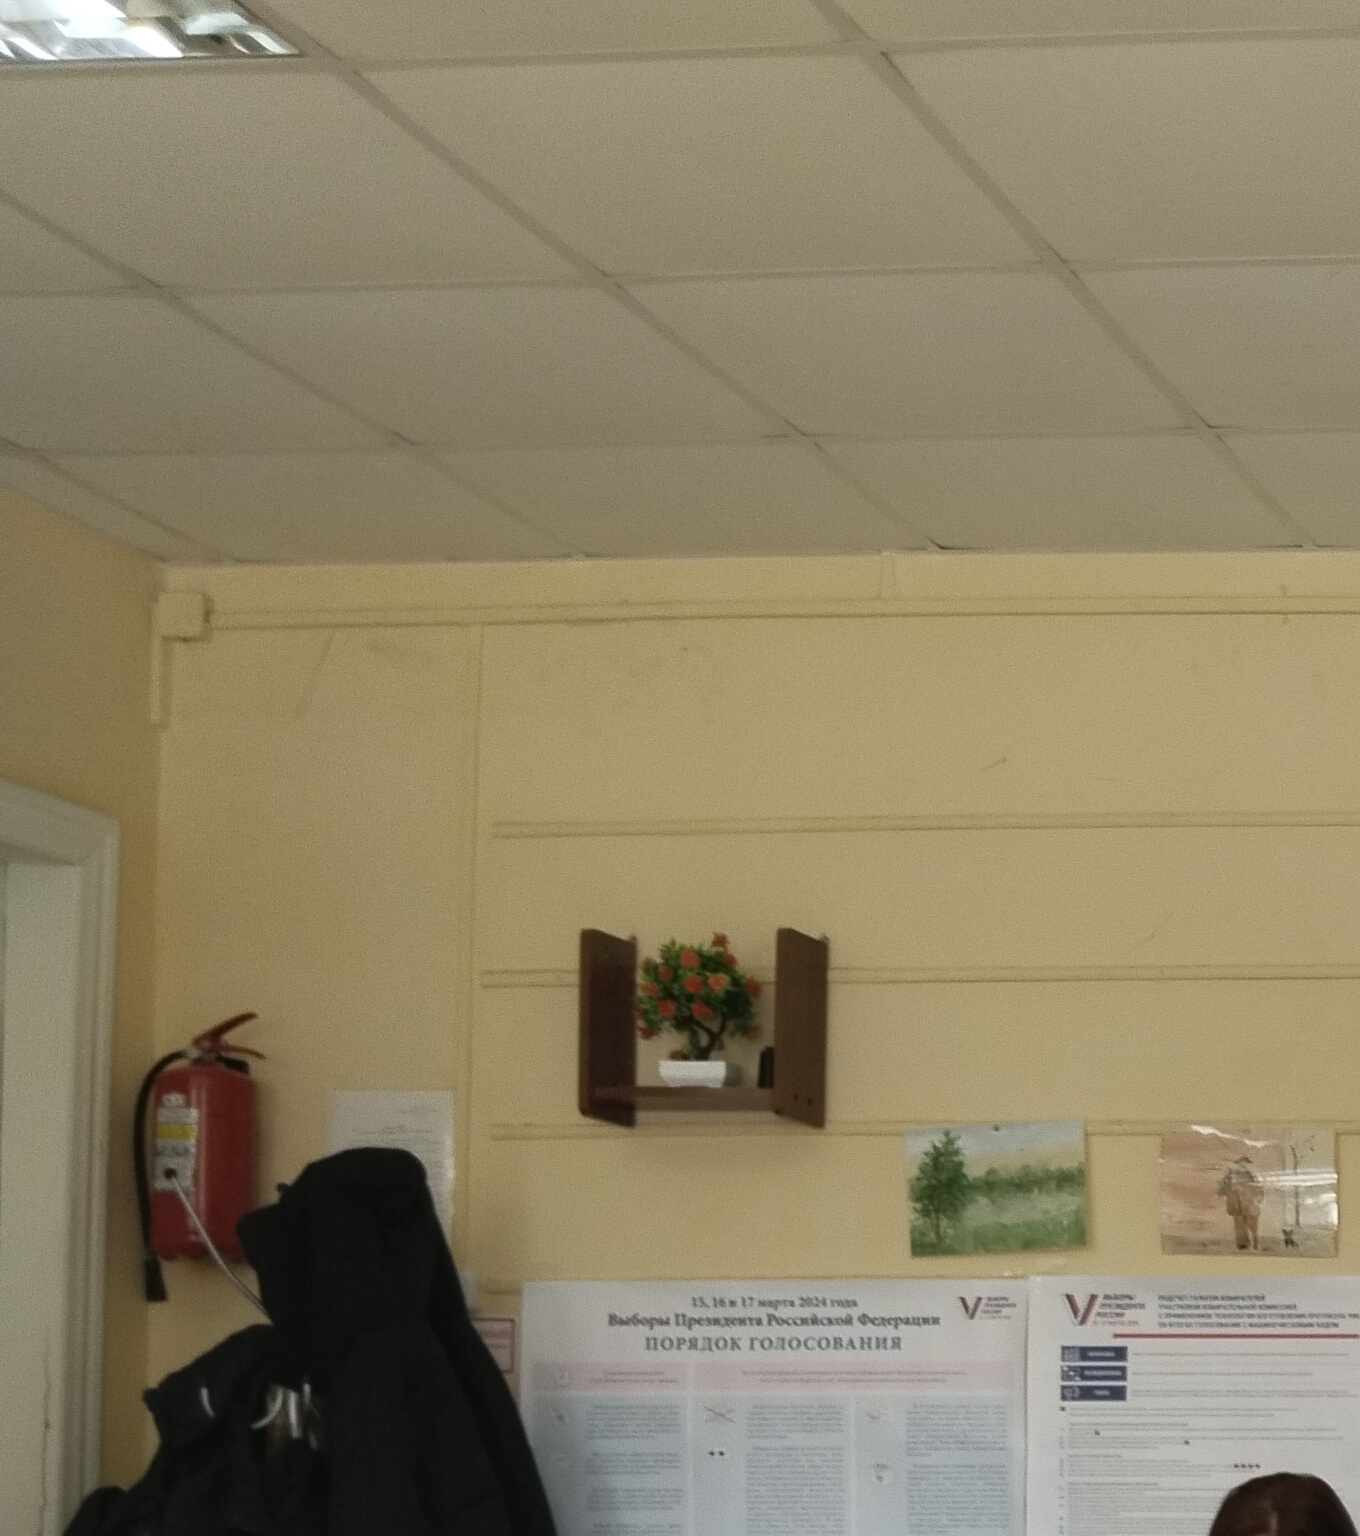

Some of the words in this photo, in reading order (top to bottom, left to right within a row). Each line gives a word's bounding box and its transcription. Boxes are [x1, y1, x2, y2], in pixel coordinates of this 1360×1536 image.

[742, 1296, 755, 1308] 17
[758, 1299, 796, 1311] марта
[608, 1312, 671, 1330] Выборы
[674, 1313, 763, 1331] Президента
[766, 1313, 853, 1328] Российской
[857, 1313, 941, 1329] Федерации
[645, 1336, 742, 1351] ПОРЯДОК
[749, 1336, 902, 1351] ГОЛОСОВАНИЯ
